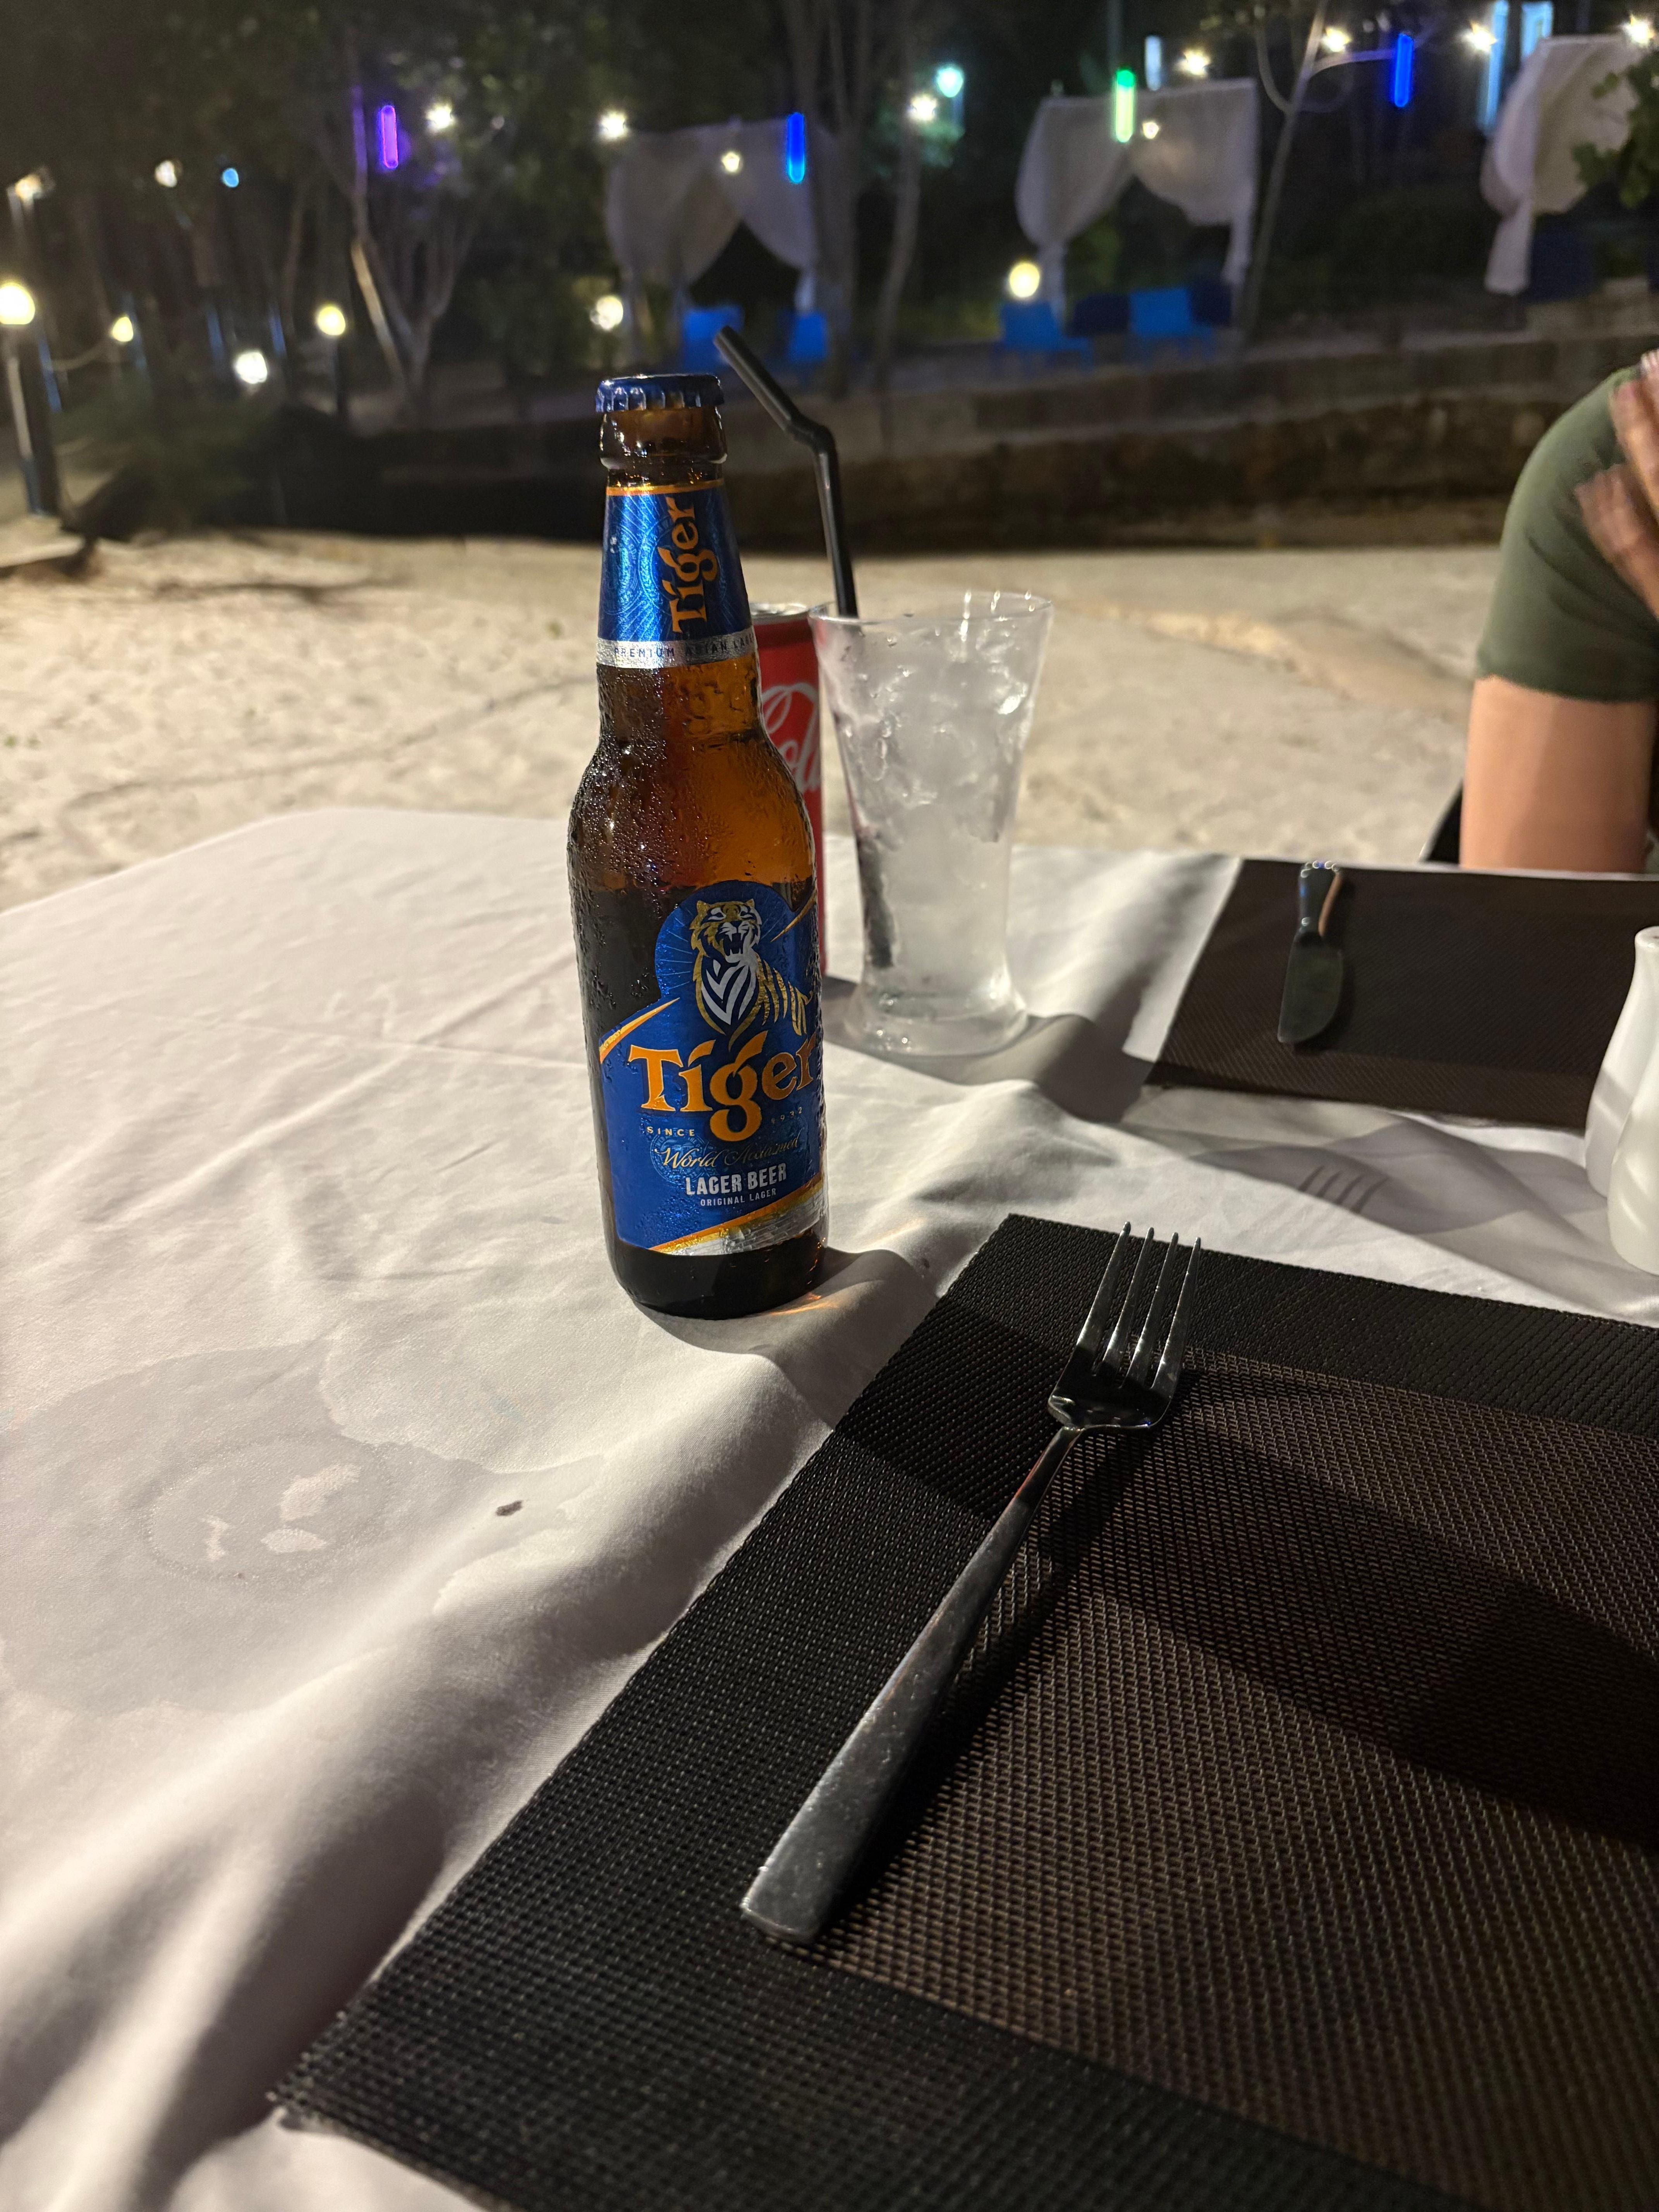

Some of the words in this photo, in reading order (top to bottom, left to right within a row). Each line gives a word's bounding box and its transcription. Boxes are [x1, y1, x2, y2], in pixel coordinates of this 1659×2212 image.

[658, 496, 718, 634] Tiger
[614, 647, 675, 658] PREMIUM
[685, 641, 727, 656] AIAN
[628, 1030, 817, 1142] Tiger
[646, 1126, 696, 1137] SINCE
[653, 1147, 730, 1169] World
[685, 1174, 742, 1196] LAGER
[747, 1163, 787, 1190] BEER
[700, 1196, 745, 1207] ORIGINAL
[749, 1188, 776, 1201] LAGER
